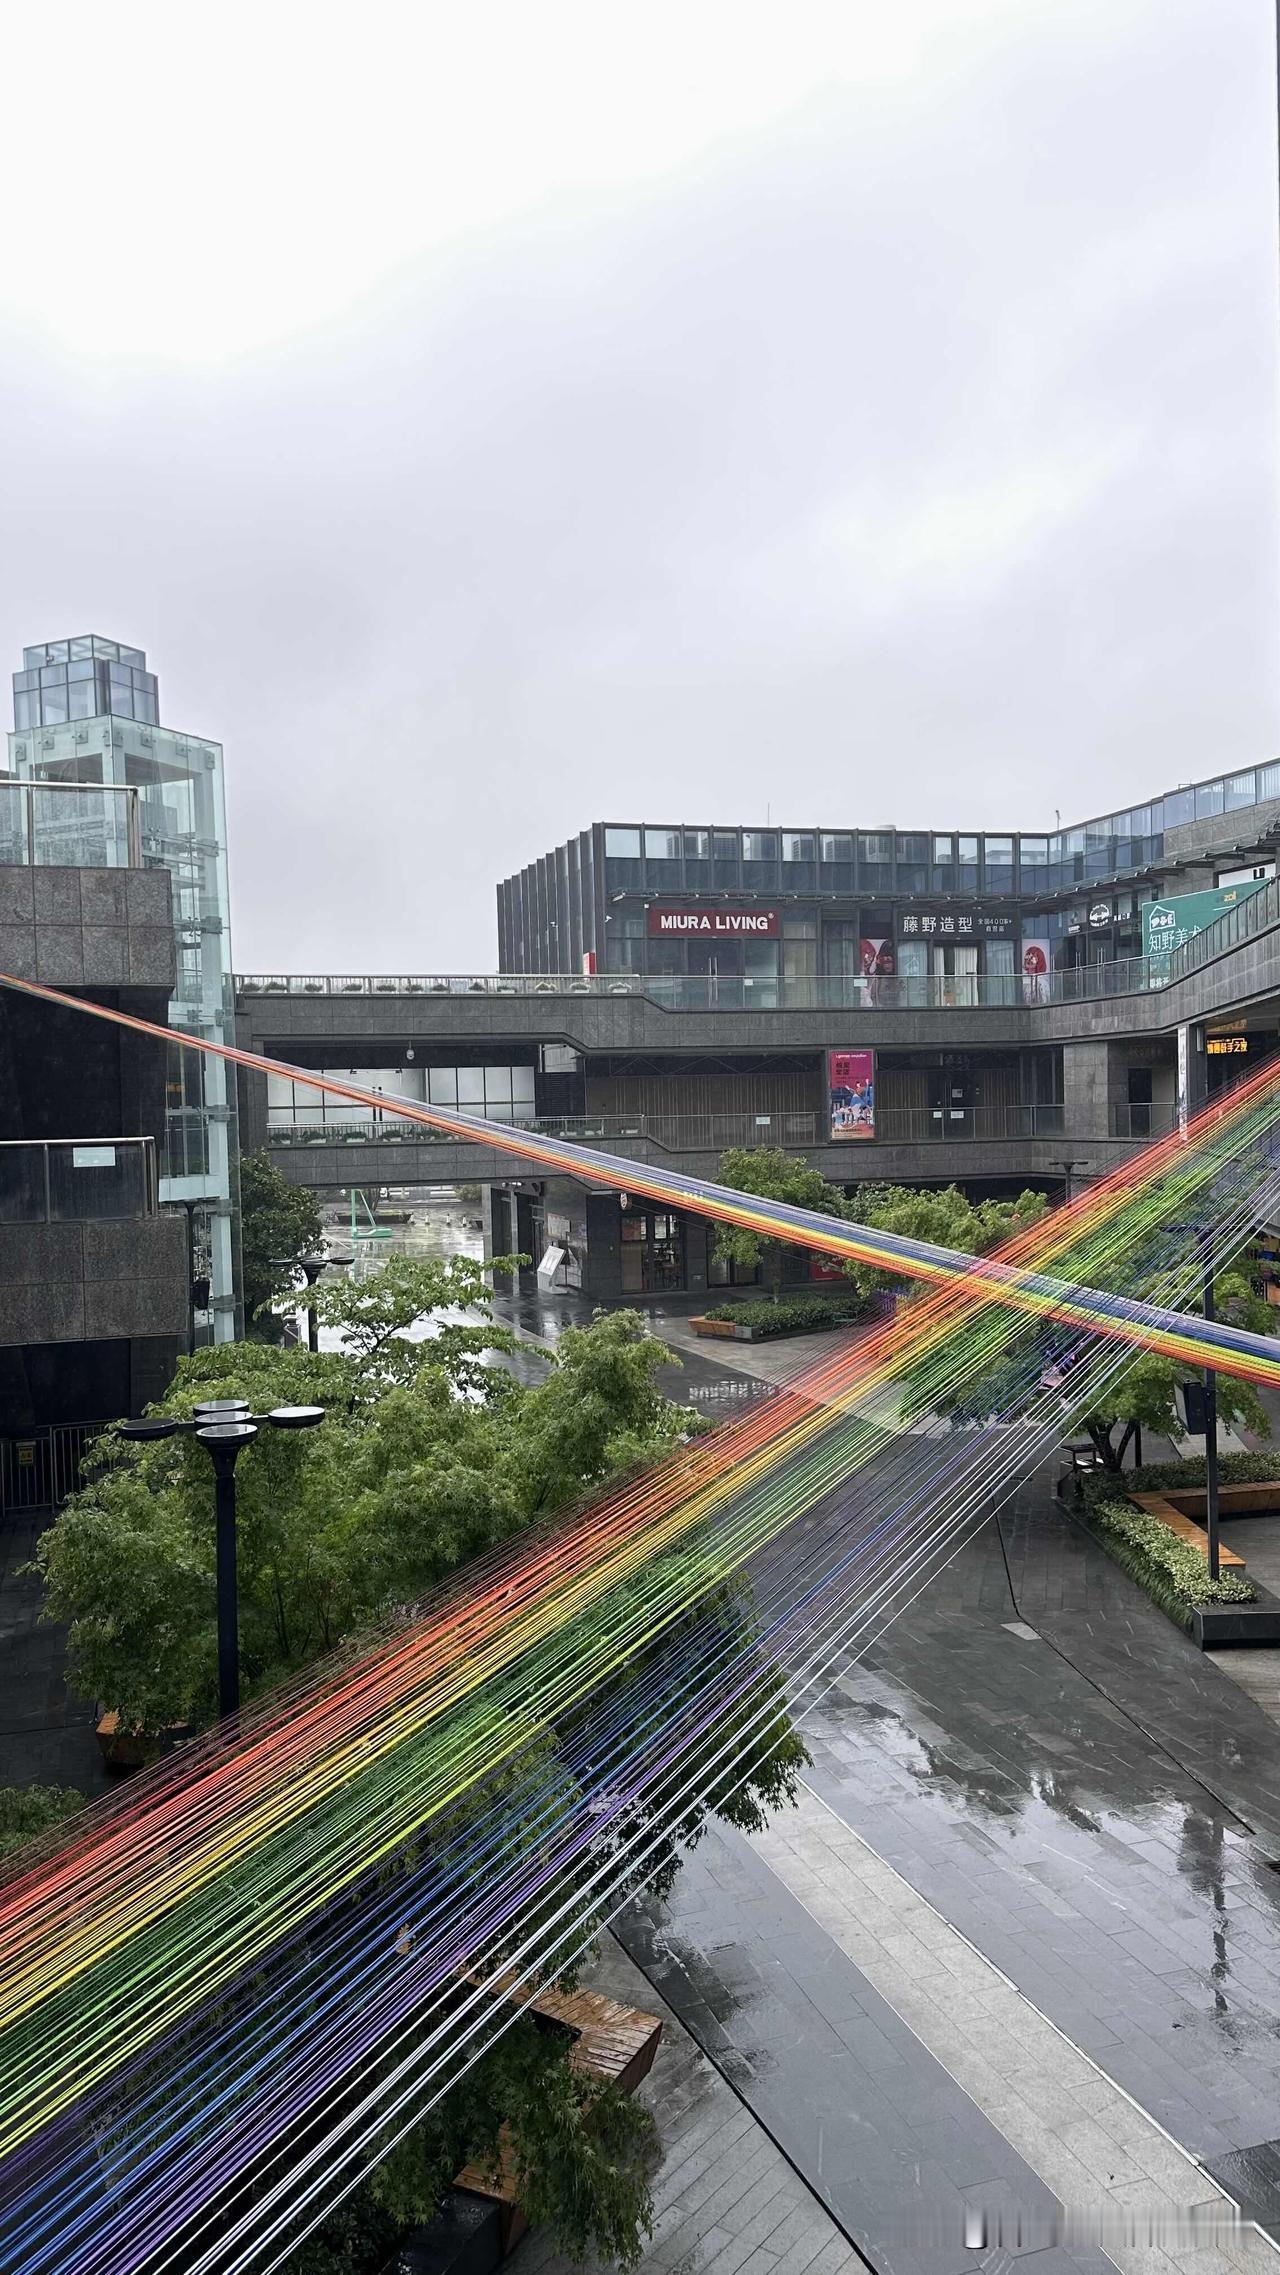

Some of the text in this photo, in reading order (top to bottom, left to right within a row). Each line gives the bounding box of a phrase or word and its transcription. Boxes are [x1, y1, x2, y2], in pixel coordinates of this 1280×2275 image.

[660, 915, 768, 930] MIURA LIVING
[903, 916, 973, 933] 藤野造型
